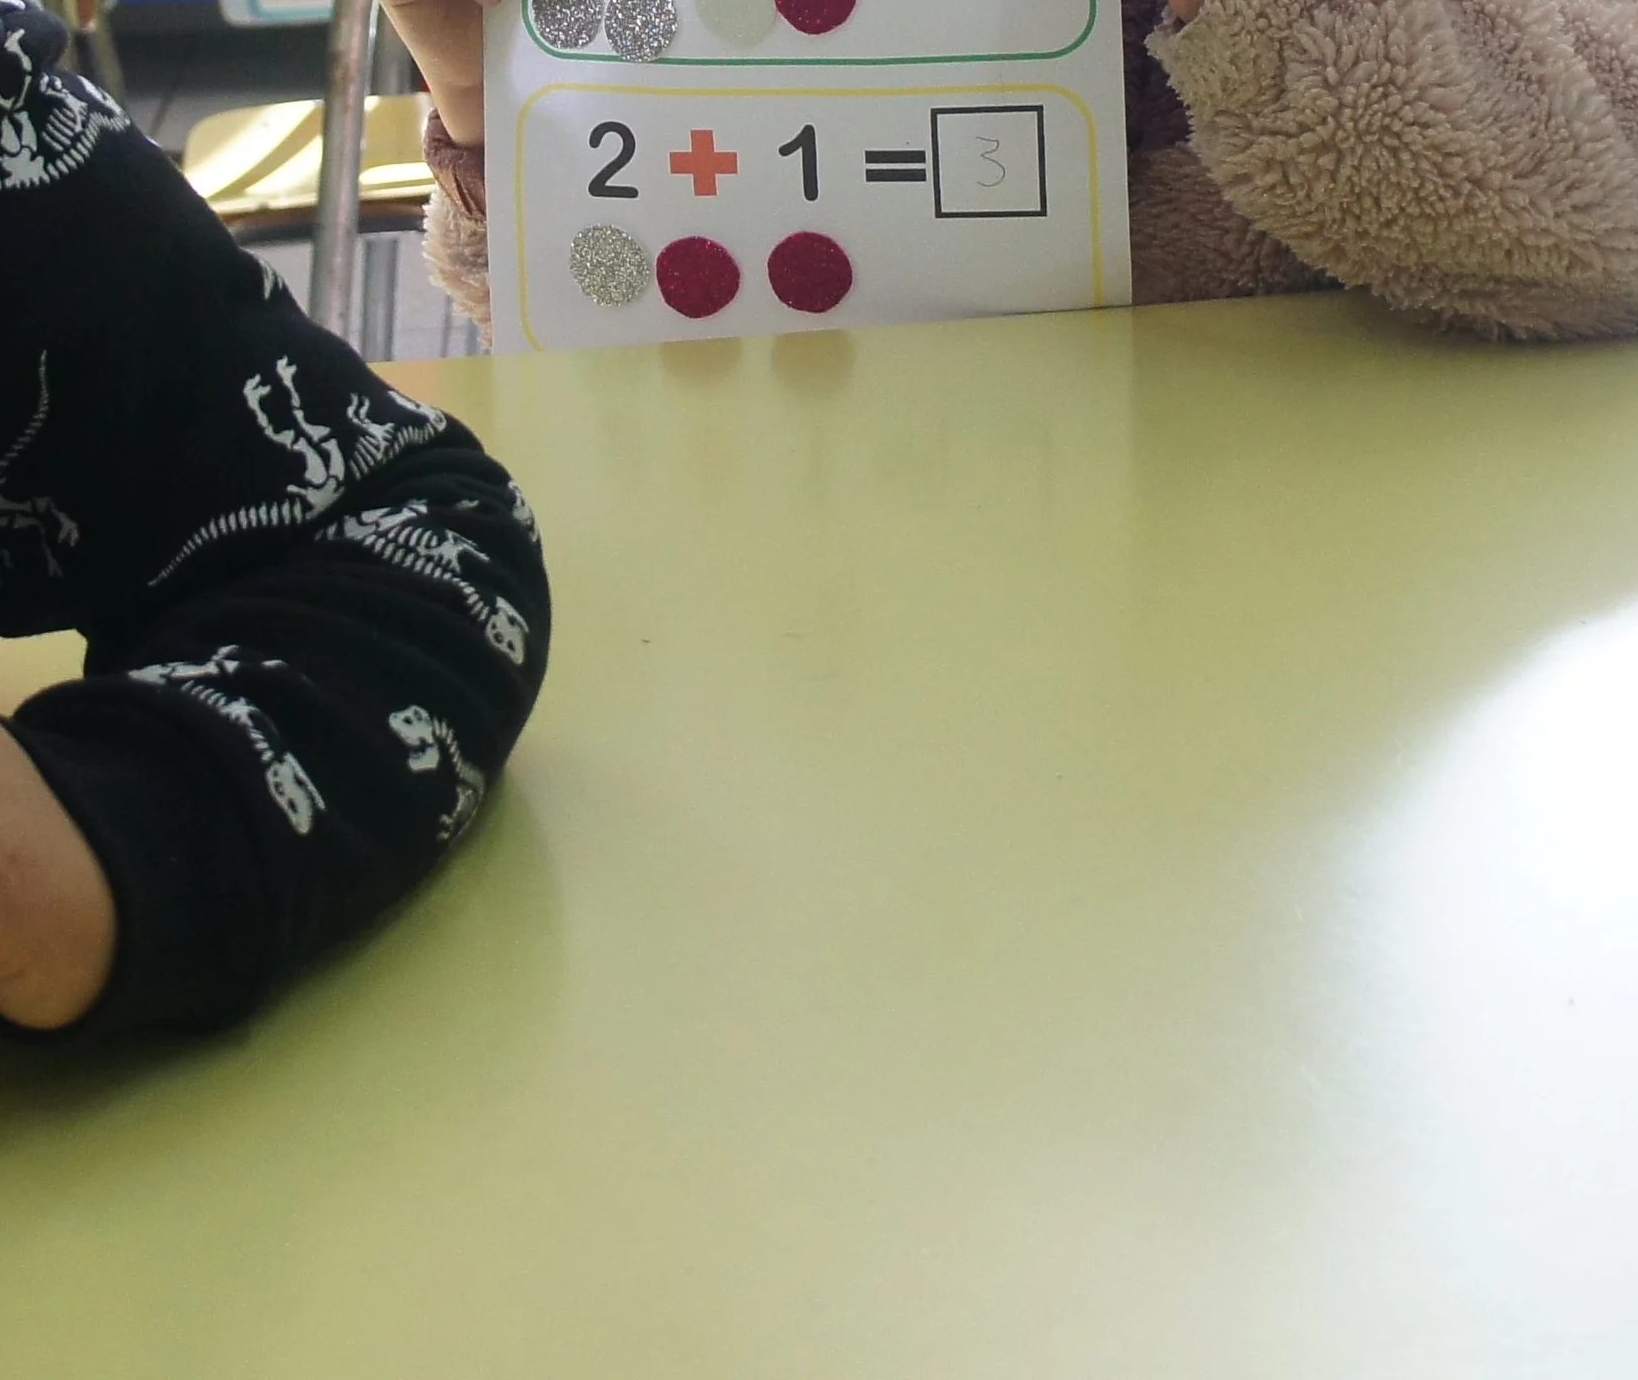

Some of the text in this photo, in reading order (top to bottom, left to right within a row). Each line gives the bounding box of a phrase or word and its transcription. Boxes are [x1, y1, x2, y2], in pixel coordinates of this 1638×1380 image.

[587, 121, 639, 199] 2
[778, 125, 819, 201] 1
[865, 150, 927, 182] =
[975, 136, 1005, 187] 3
